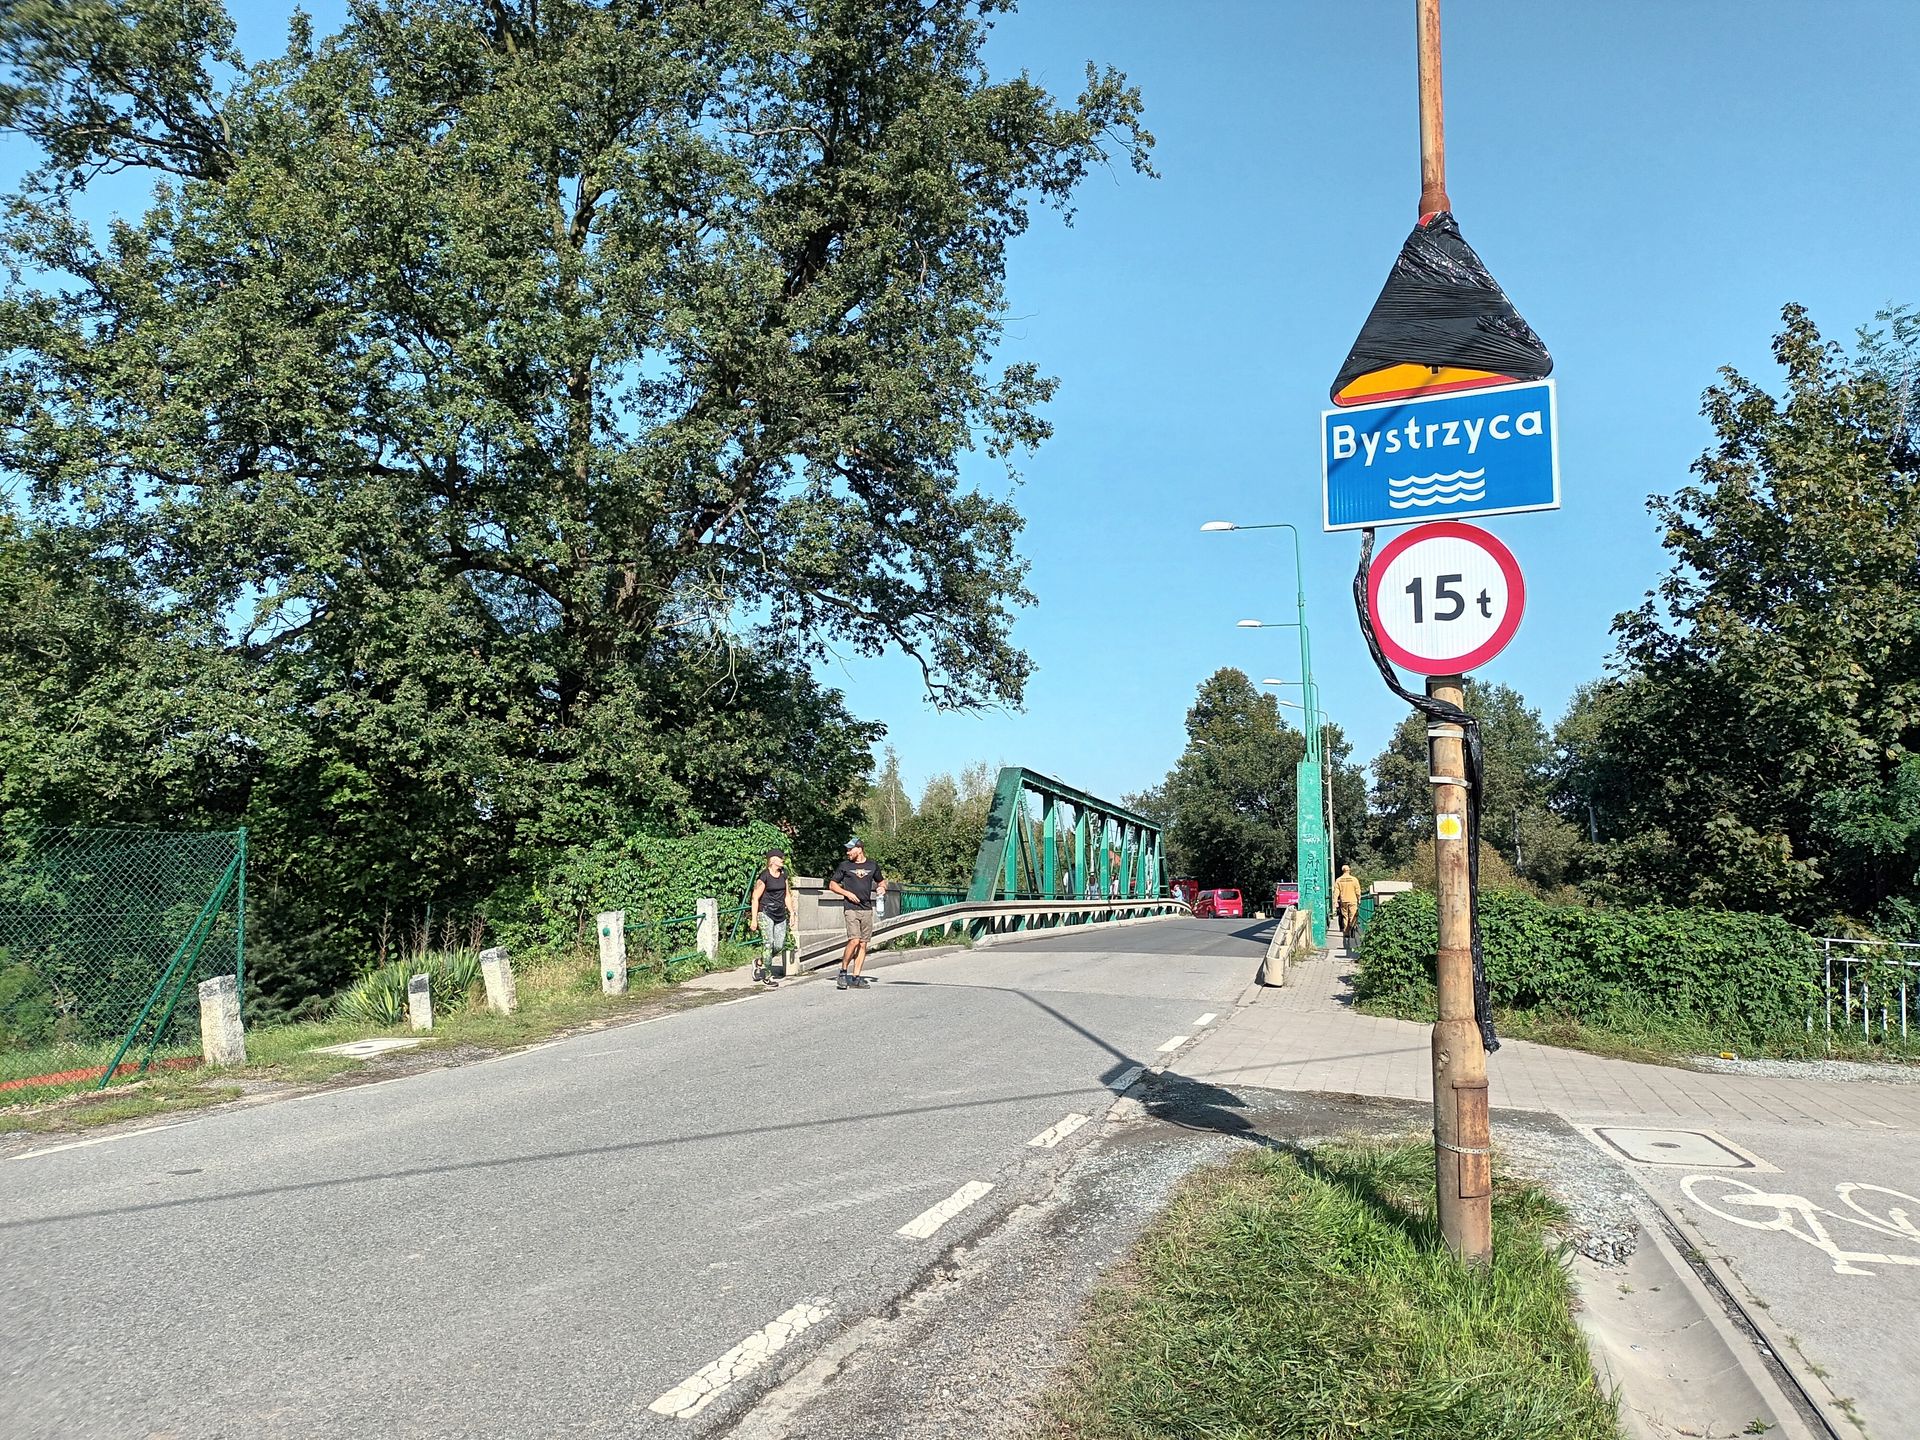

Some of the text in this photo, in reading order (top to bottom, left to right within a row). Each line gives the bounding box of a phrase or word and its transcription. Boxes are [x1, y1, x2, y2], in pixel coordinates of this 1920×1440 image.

[1332, 410, 1543, 467] Bystrzyca
[1405, 573, 1493, 624] 15 t
